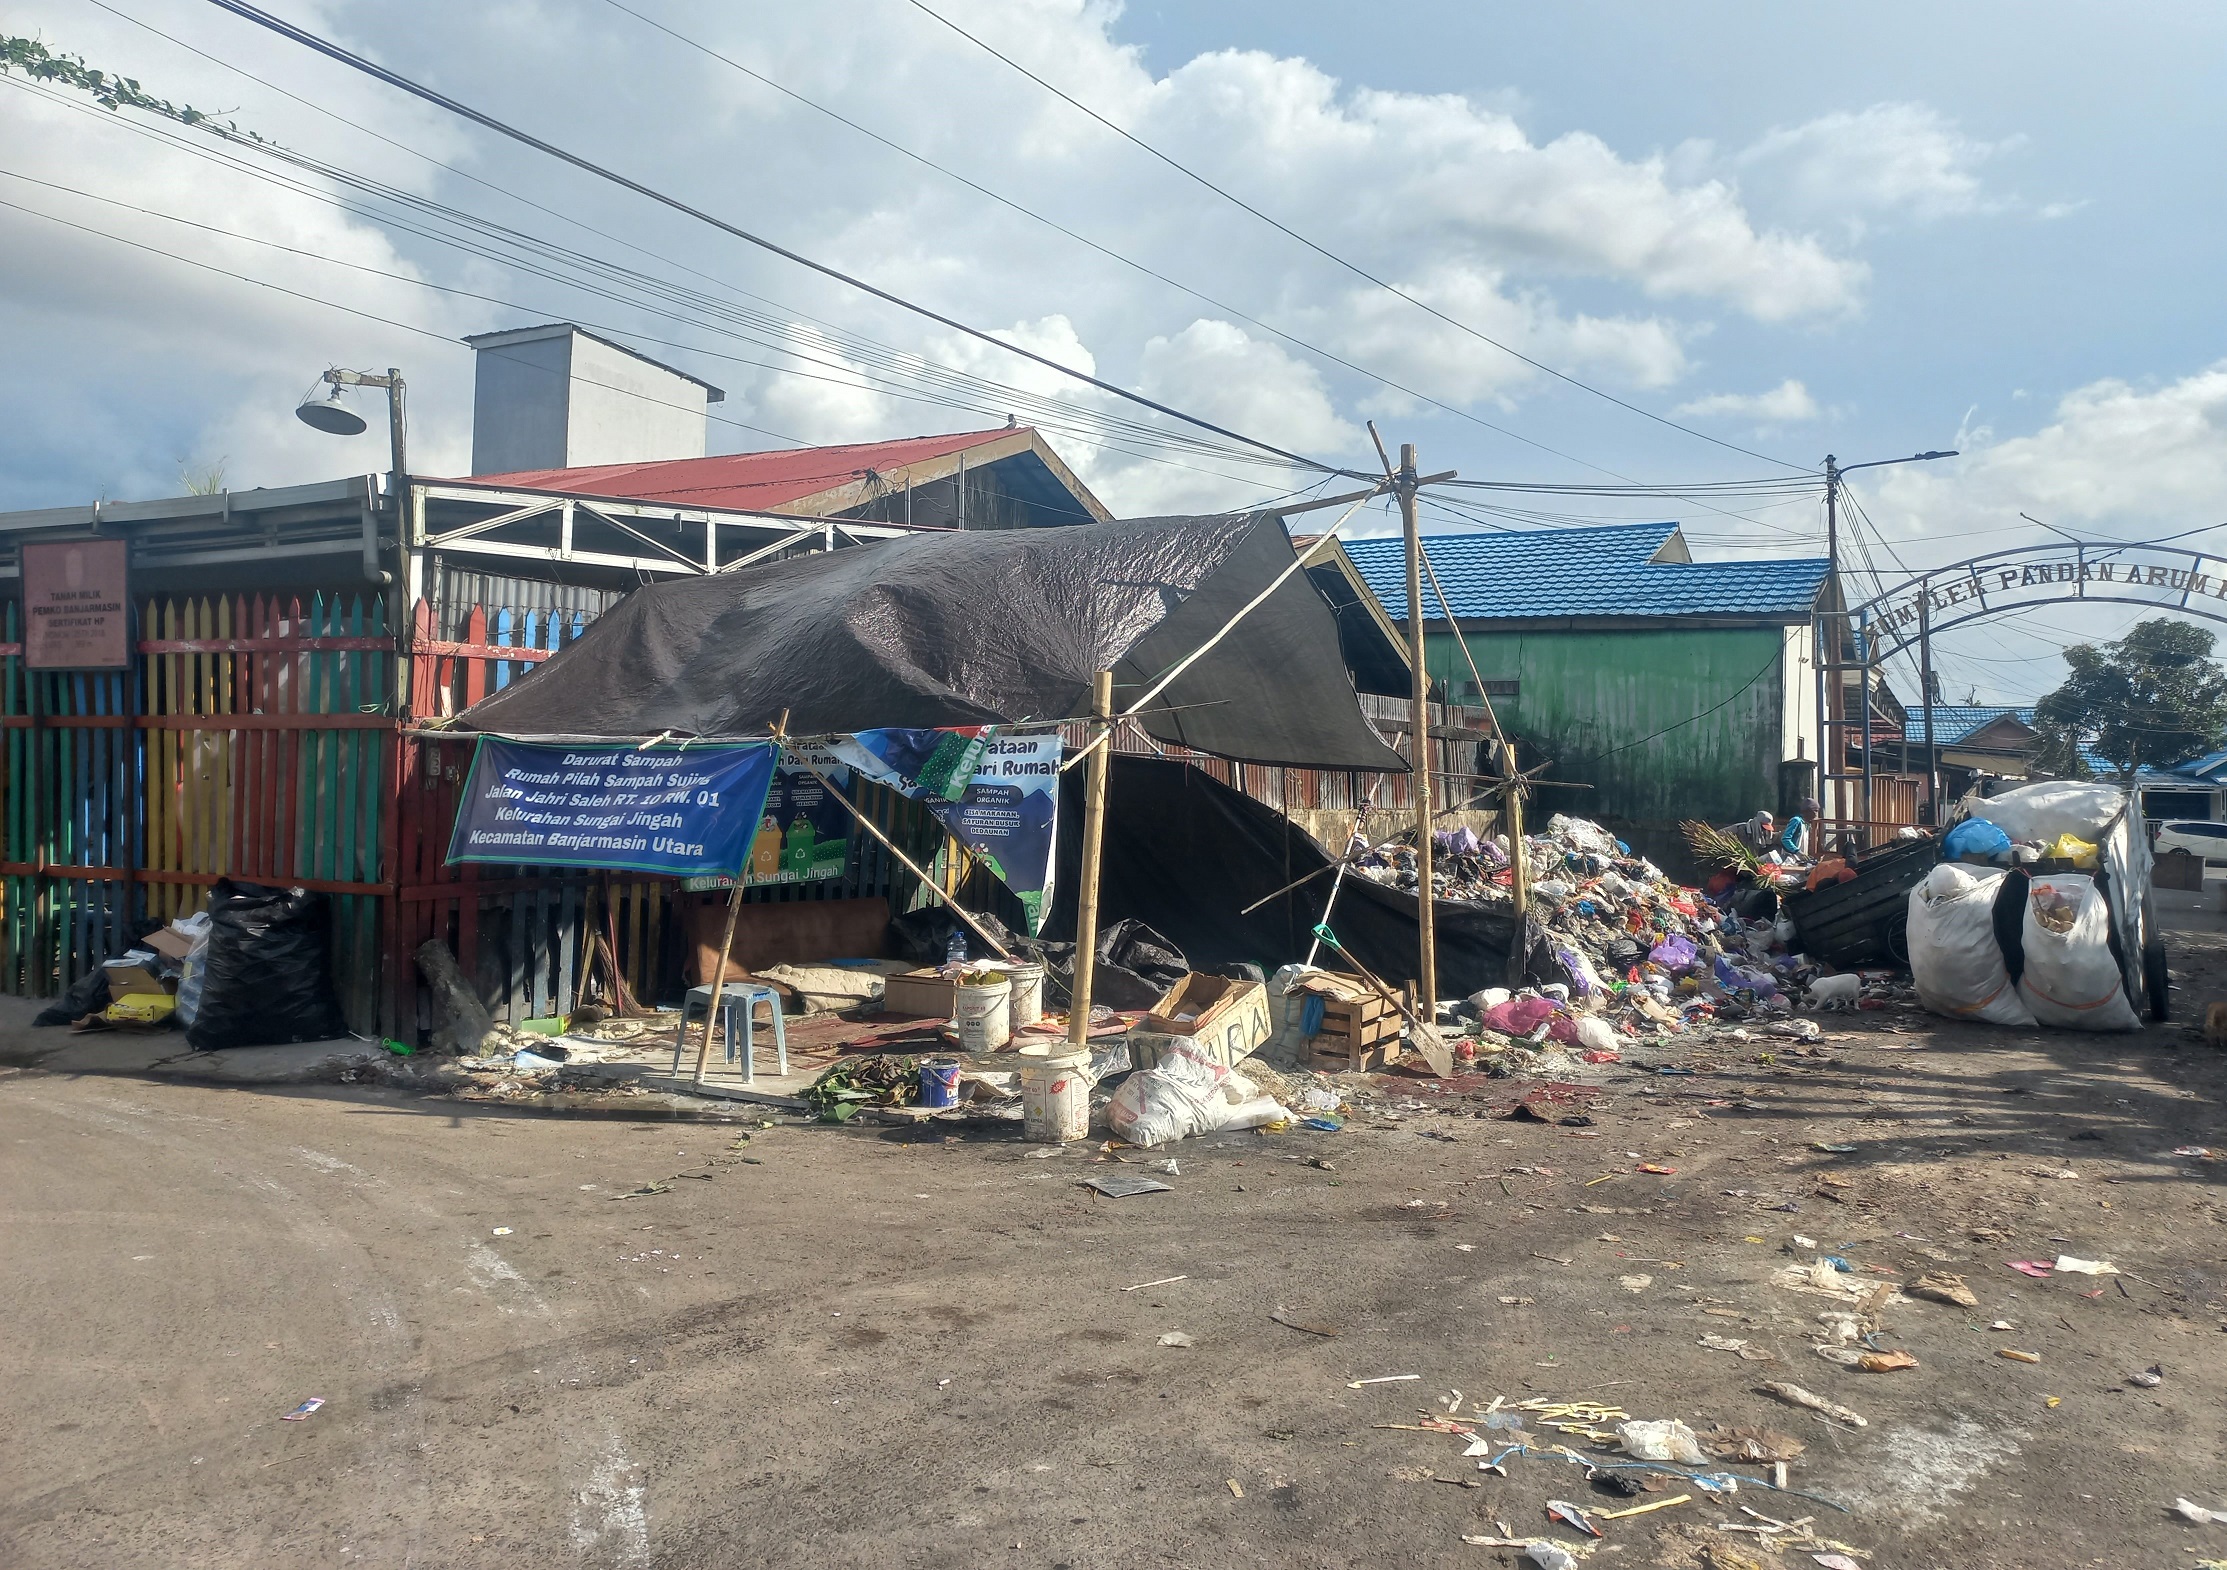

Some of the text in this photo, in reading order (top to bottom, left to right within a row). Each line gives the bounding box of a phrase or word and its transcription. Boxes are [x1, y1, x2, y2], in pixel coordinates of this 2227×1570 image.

[1999, 562, 2115, 590] PANDAN
[2125, 564, 2211, 594] ARUM
[50, 590, 101, 601] TANAH MILIK
[32, 602, 121, 616] PEMKO BANJARMASIN
[48, 618, 92, 628] SERTIFIKAT
[562, 753, 683, 769] Darurat Sampah
[973, 761, 997, 776] ari
[505, 768, 560, 785] Rumah
[562, 773, 600, 786] Pilah
[604, 774, 663, 790] Sampah
[485, 784, 720, 808] Jalan Jahri Saleh RT. 10 RW. 01
[976, 788, 1010, 796] SAMPAH
[495, 806, 683, 830] Kelurahan Sungai Jingah
[469, 830, 704, 856] Kecamatan Banjarmasin Utara
[757, 868, 799, 884] Sungai
[803, 864, 838, 879] Jingah
